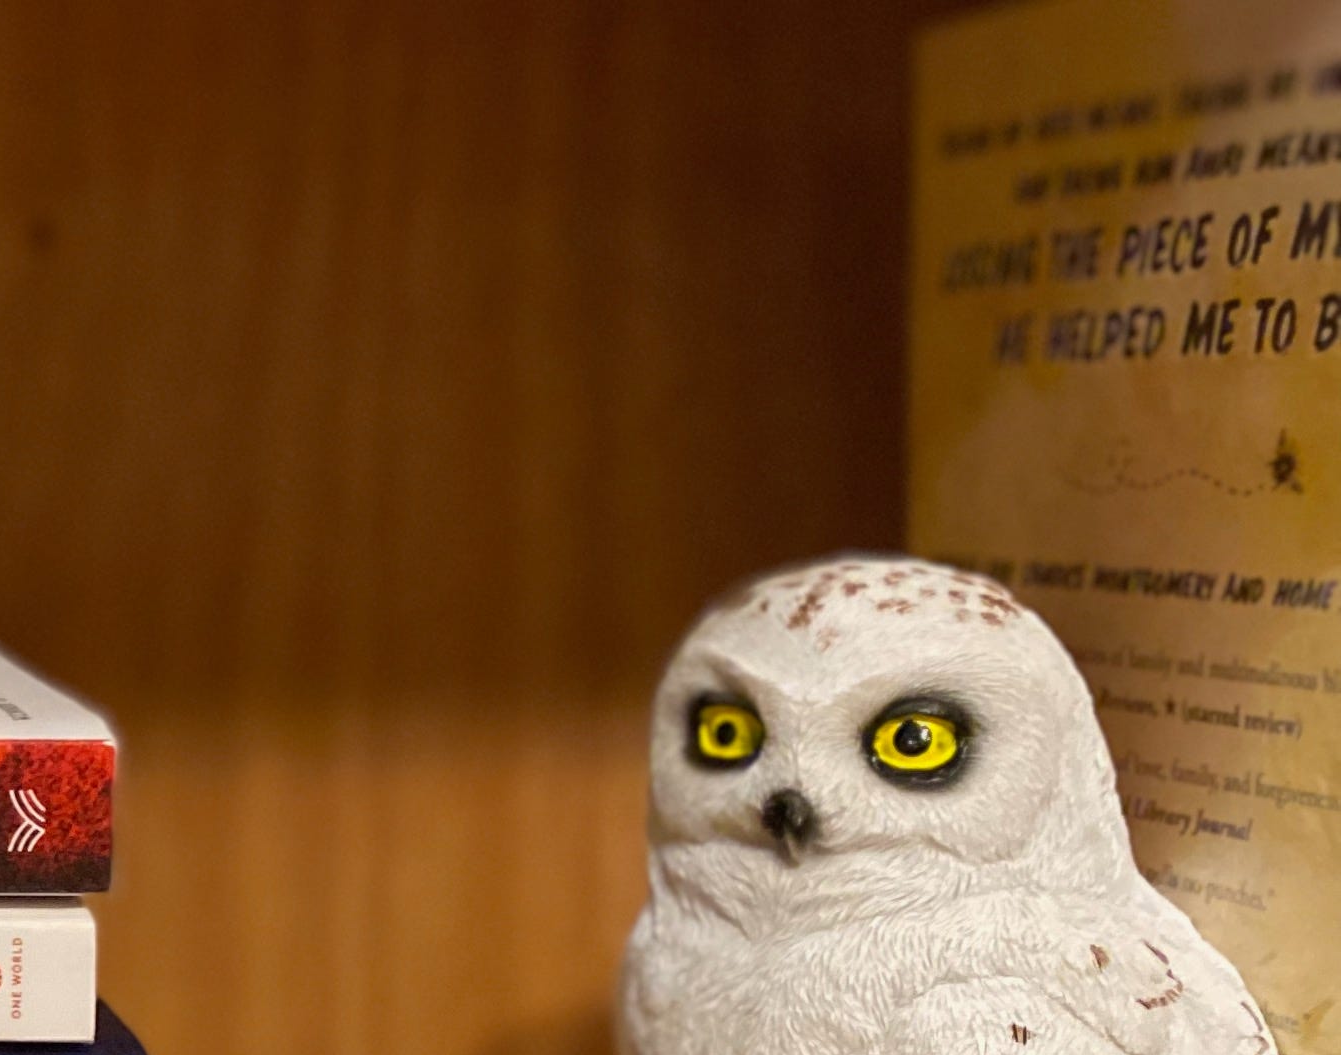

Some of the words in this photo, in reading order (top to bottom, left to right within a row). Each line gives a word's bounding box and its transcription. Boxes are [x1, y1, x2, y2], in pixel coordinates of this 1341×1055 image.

[1119, 212, 1214, 280] PIECE
[1227, 206, 1279, 267] OF
[1047, 307, 1166, 363] HELPED
[1182, 299, 1240, 356] ME
[1254, 298, 1296, 354] TO
[1222, 572, 1264, 604] AND
[1273, 580, 1337, 609] HOME
[11, 937, 23, 986] WORLD
[11, 991, 22, 1020] ONE
